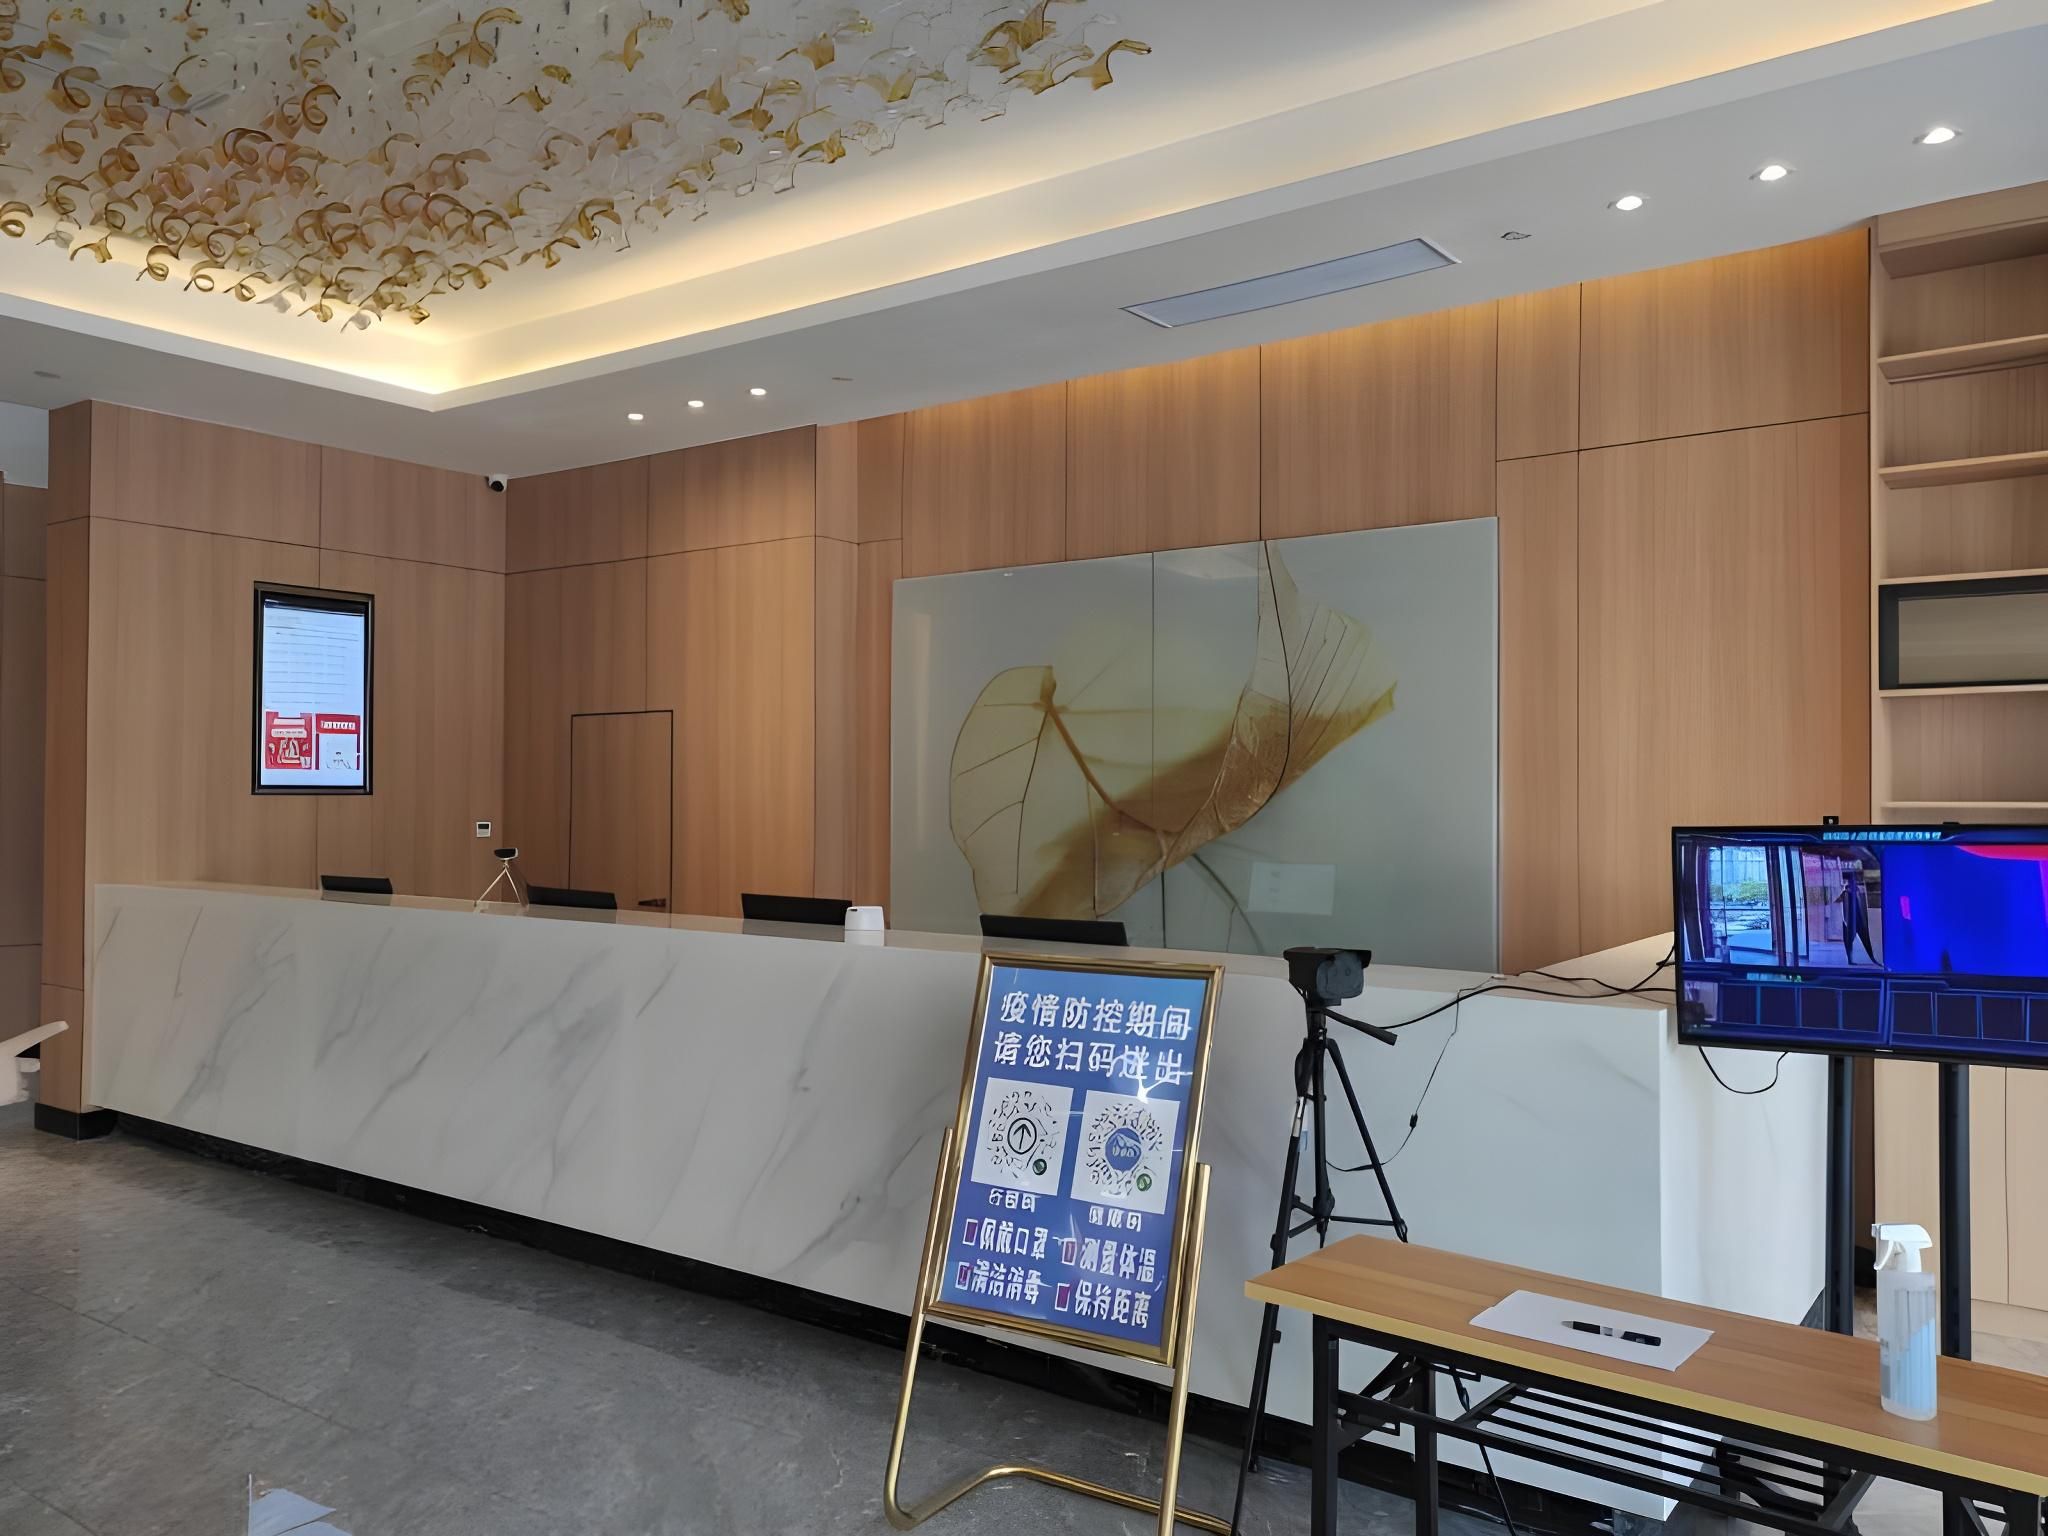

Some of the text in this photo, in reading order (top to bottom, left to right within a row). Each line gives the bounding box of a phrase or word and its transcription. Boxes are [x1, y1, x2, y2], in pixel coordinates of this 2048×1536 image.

[1000, 991, 1190, 1040] 疫情防控期间
[994, 1031, 1182, 1085] 请您扫码进出
[1075, 1279, 1151, 1328] 保持距离
